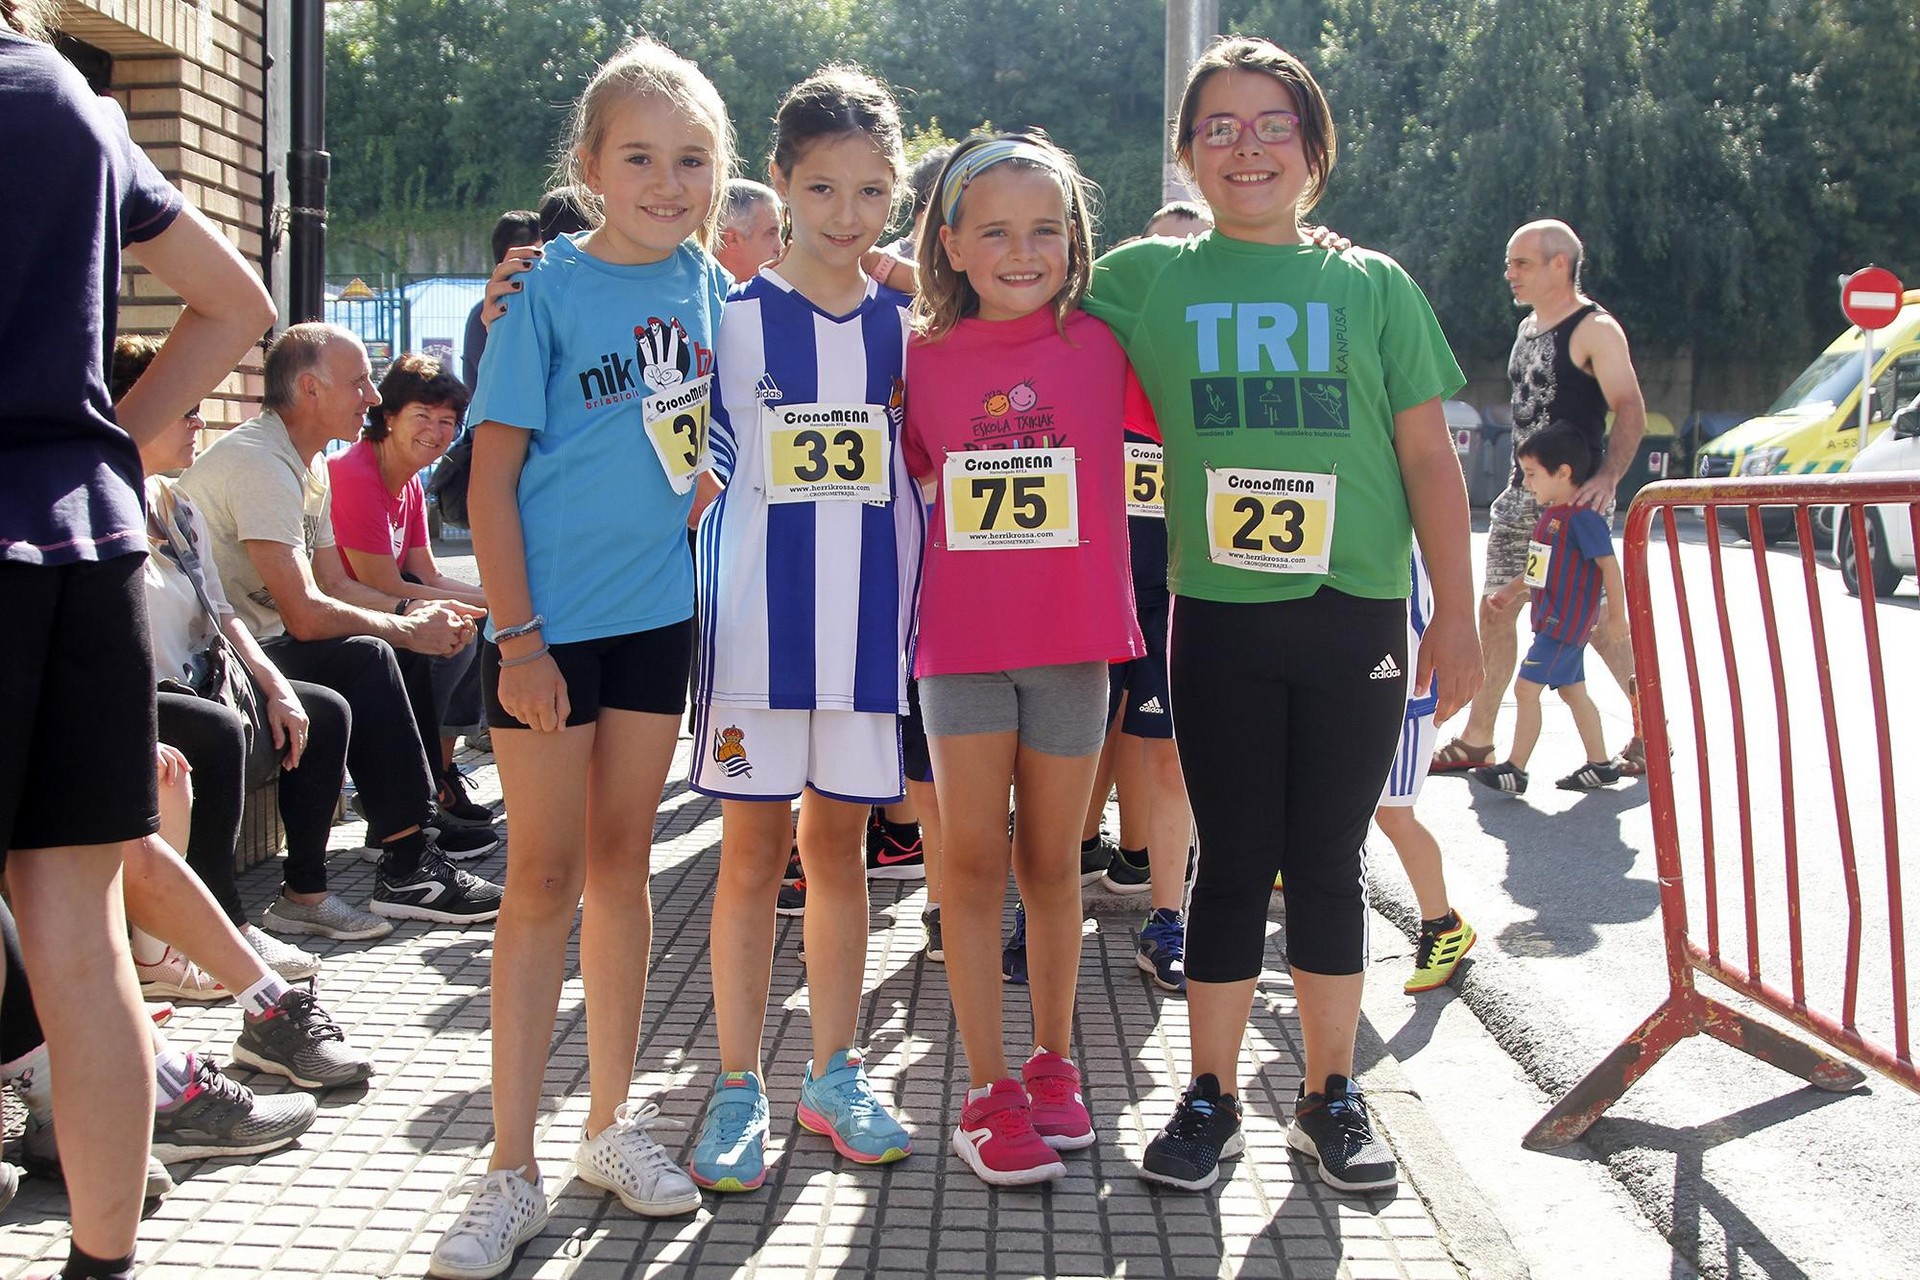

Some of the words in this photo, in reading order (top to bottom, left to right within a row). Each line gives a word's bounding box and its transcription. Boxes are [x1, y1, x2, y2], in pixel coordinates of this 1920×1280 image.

[1185, 302, 1331, 373] TRI
[1335, 306, 1349, 374] KANPUSA
[579, 352, 635, 401] nik
[784, 410, 869, 425] CronoMENA
[972, 419, 1011, 437] ESKOLA
[793, 429, 865, 482] 33
[964, 455, 1053, 471] CronoMENA
[789, 484, 871, 493] www.herrikrossa.com
[1133, 463, 1165, 502] 5
[1228, 475, 1315, 493] CronoMENA
[971, 476, 1047, 530] 75
[1232, 496, 1305, 553] 23
[969, 531, 1054, 540] www.herrikrossa.com
[1228, 551, 1306, 563] www.herrikrossa.com
[1369, 669, 1401, 679] adidas
